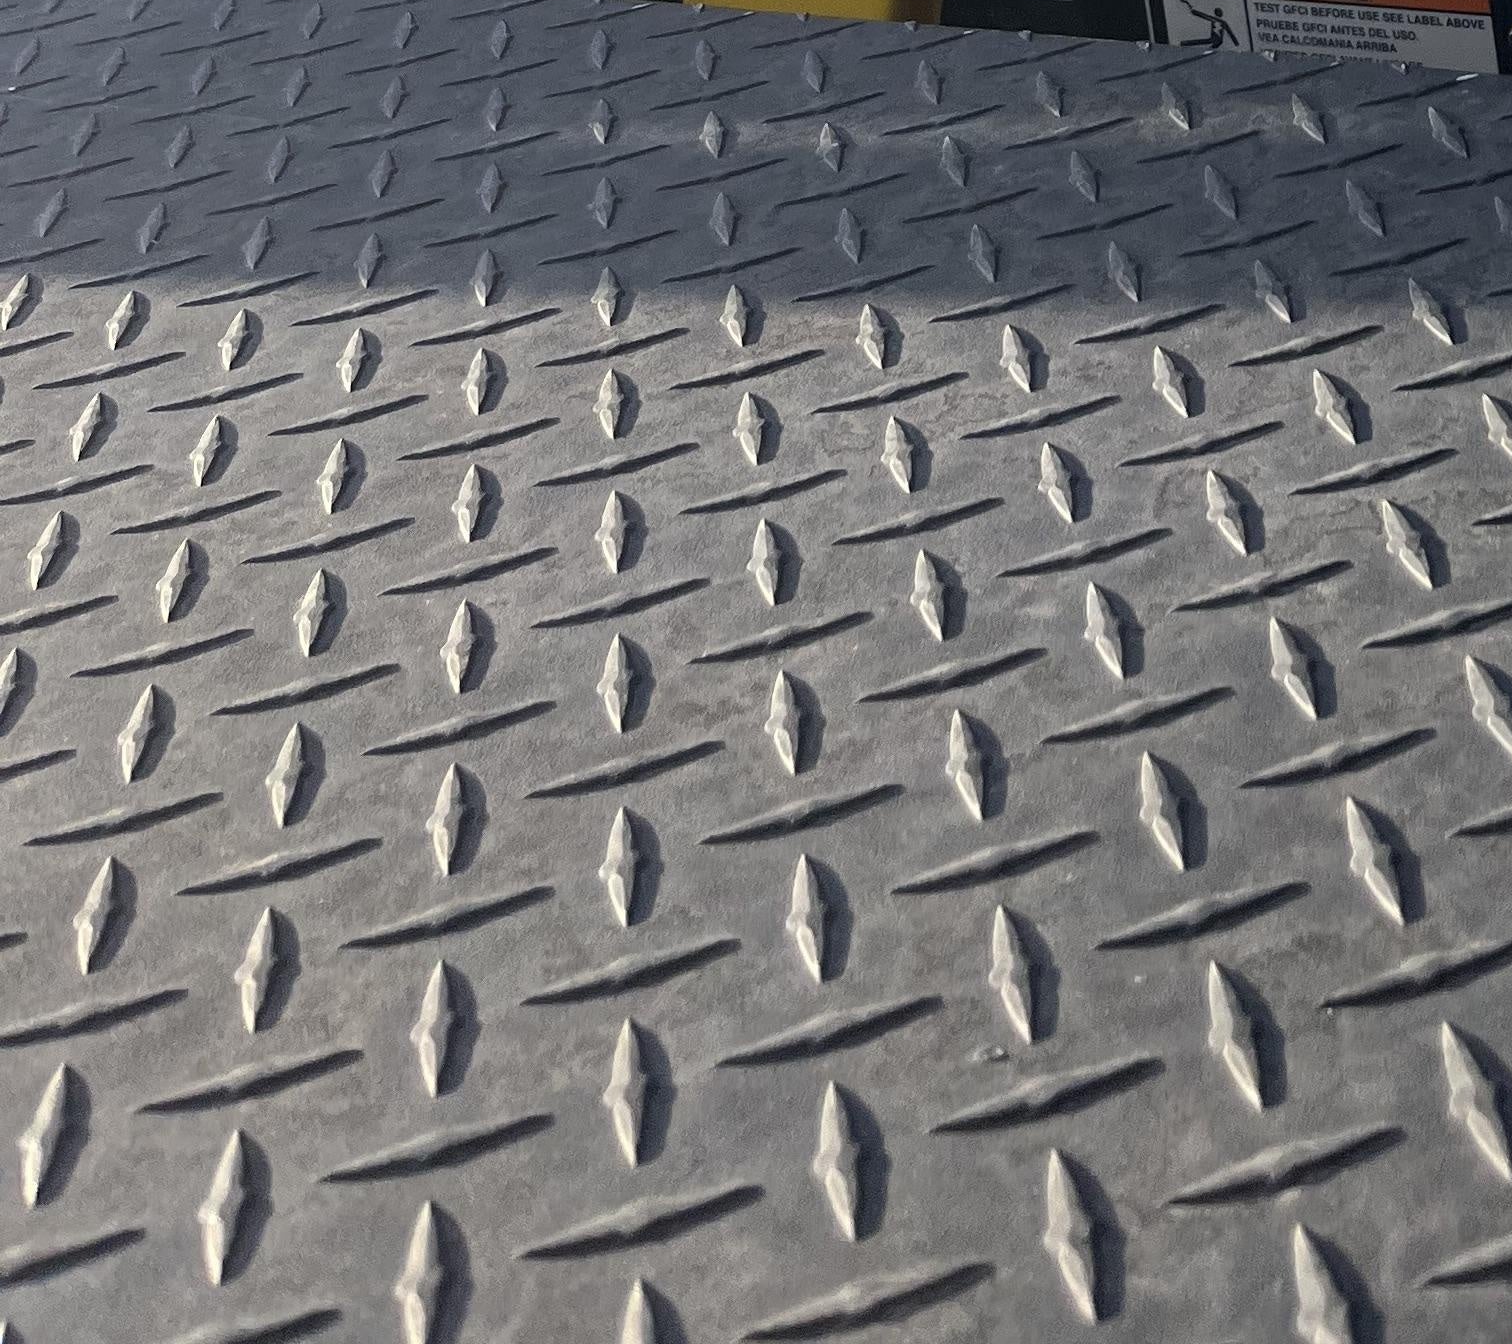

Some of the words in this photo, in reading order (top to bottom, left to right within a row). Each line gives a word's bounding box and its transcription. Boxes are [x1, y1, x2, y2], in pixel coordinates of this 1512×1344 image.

[1253, 2, 1280, 14] TEST
[1283, 4, 1308, 16] GFCI
[1312, 6, 1354, 20] BEFORE
[1357, 10, 1380, 22] USE
[1382, 12, 1405, 24] SEE
[1407, 15, 1444, 27] LABEL
[1446, 17, 1486, 30] ABOVE
[1256, 18, 1299, 32] PRUEBE
[1302, 21, 1328, 34] GFCI
[1330, 23, 1366, 37] ANTES
[1368, 27, 1391, 39] DEL
[1258, 31, 1279, 43] VEA
[1356, 39, 1398, 53] ARRIBA
